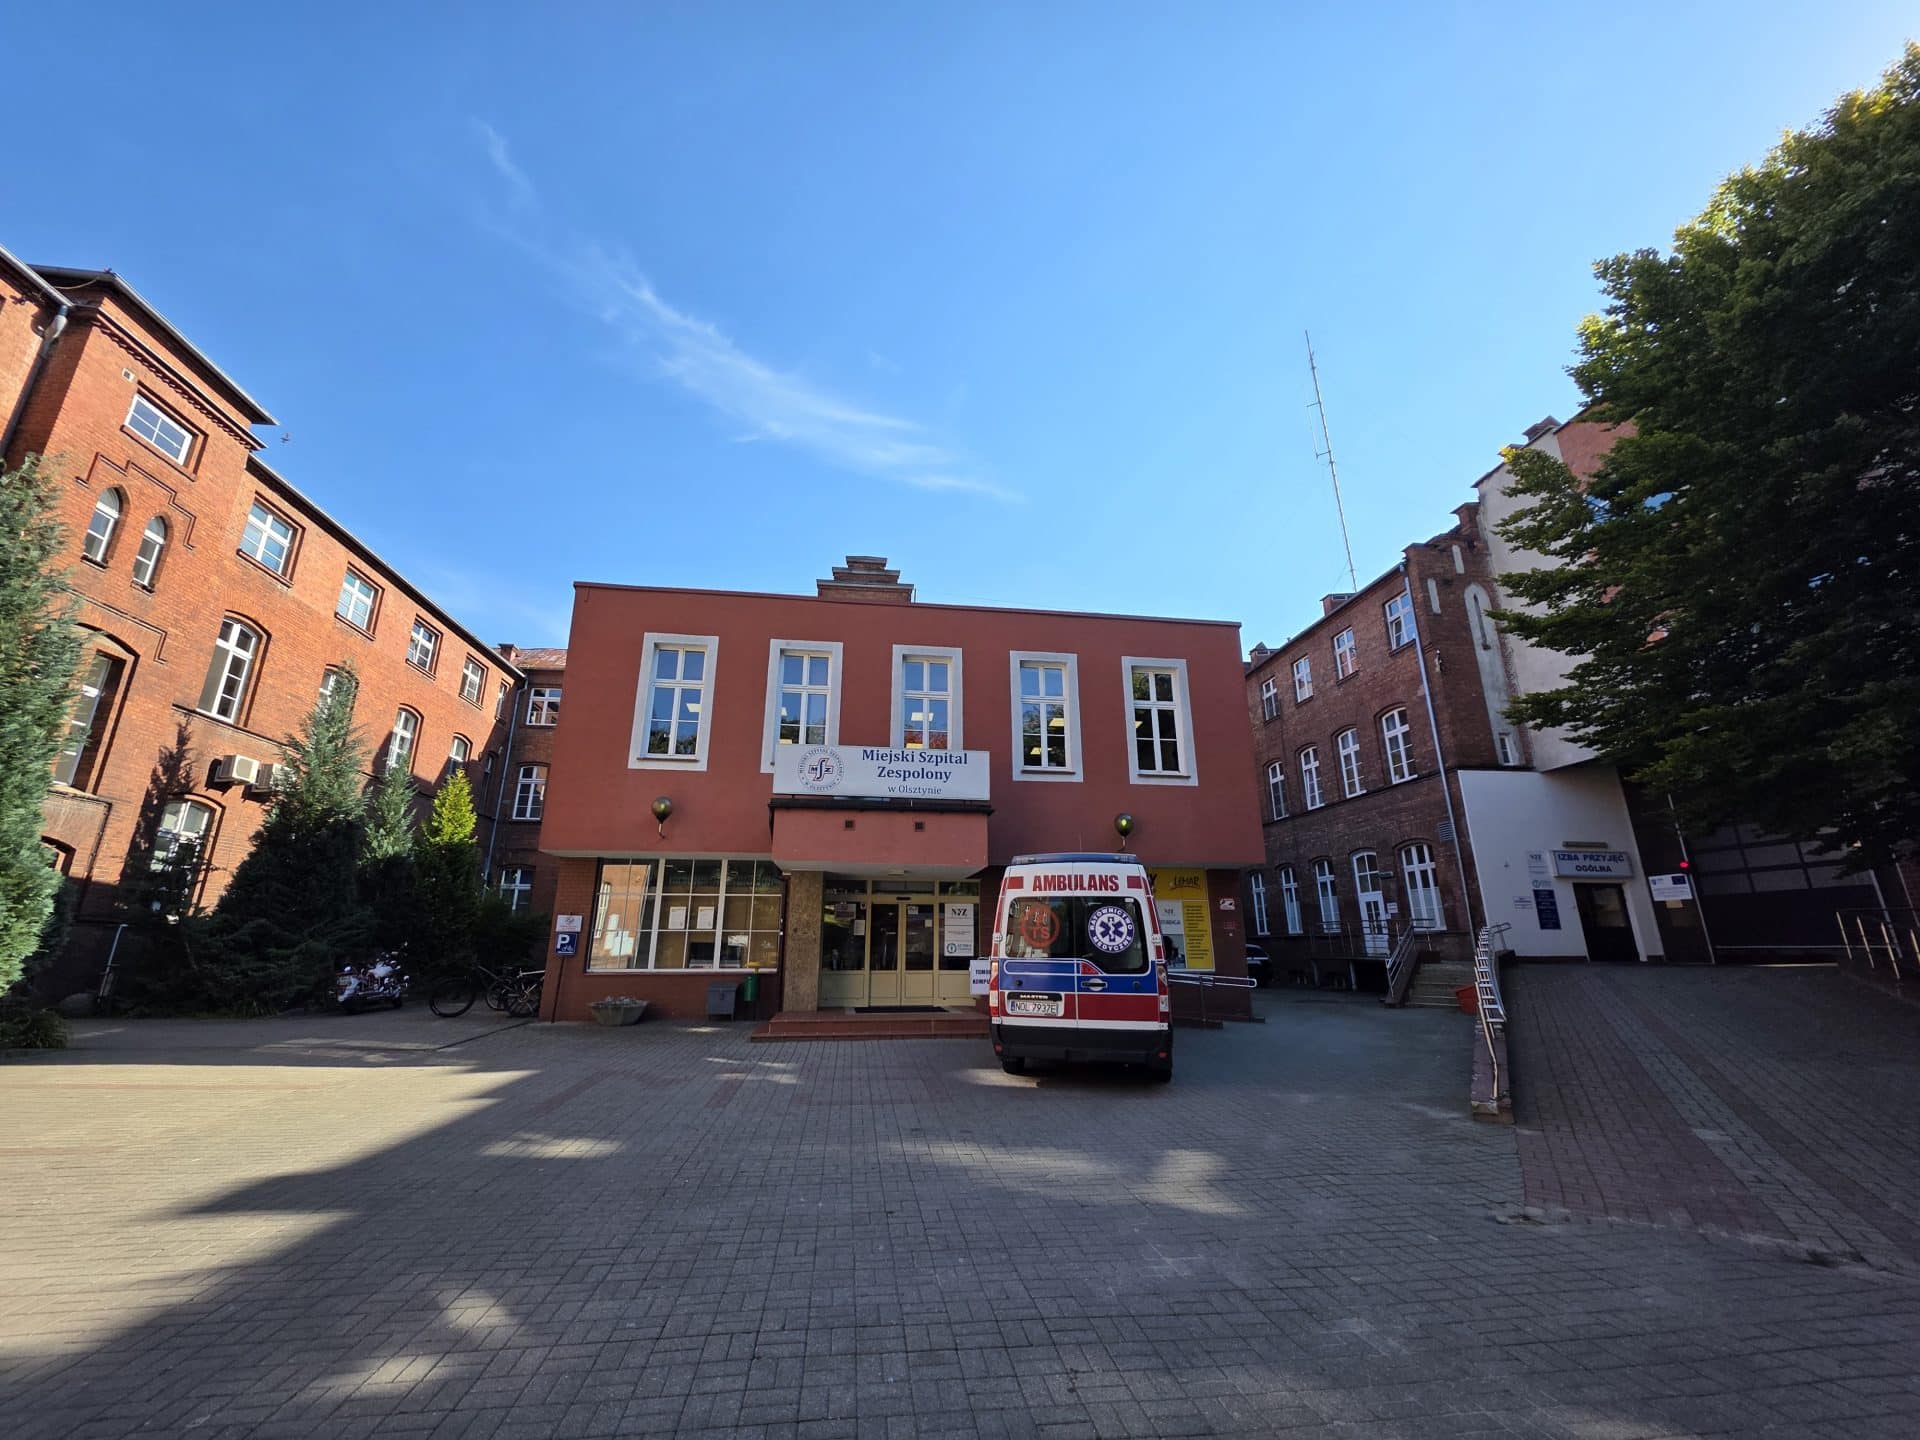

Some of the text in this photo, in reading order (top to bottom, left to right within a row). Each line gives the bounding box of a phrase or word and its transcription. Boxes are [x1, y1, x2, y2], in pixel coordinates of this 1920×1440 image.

[861, 749, 968, 767] Miejski Szpital
[876, 766, 952, 783] Zespolony
[887, 784, 942, 796] w Olsztynie
[1557, 853, 1580, 862] IZBA
[1575, 863, 1613, 873] OGÓLNA
[1032, 874, 1119, 892] AMBULANS
[1089, 908, 1133, 931] RATOWNICTWO
[556, 934, 570, 949] P
[1092, 935, 1132, 951] MEDYCZNE
